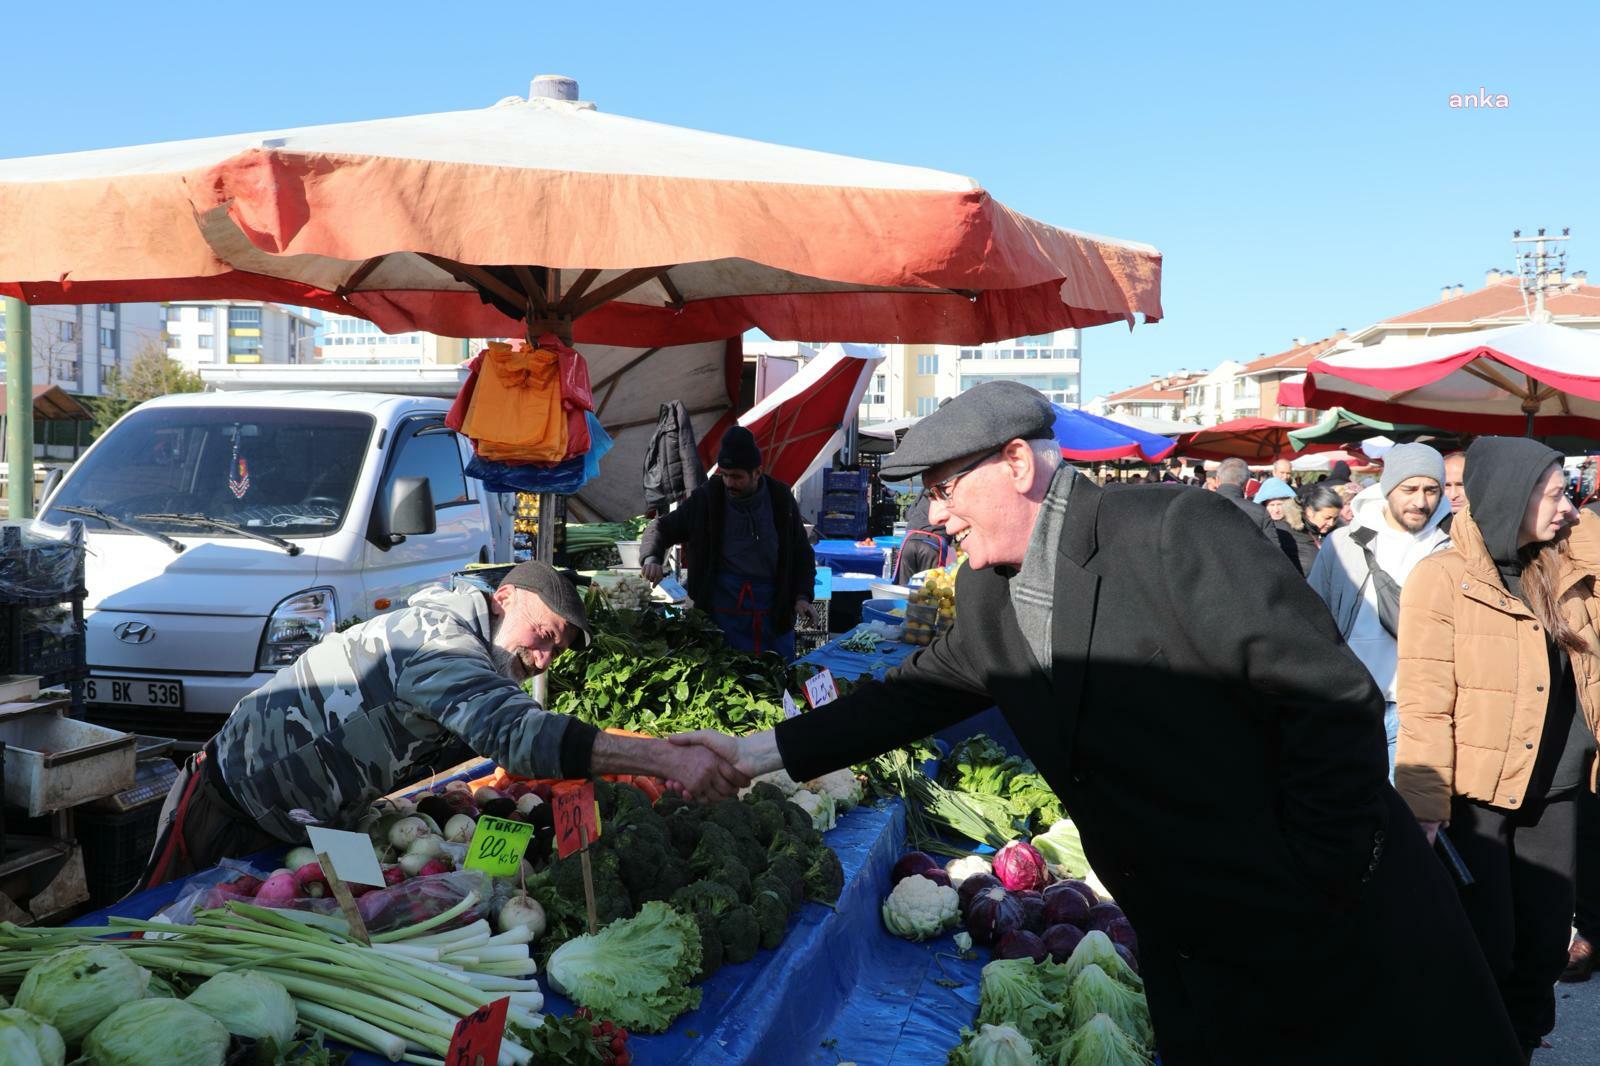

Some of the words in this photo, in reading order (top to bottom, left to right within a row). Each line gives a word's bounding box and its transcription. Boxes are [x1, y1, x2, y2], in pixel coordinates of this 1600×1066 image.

[112, 681, 132, 702] BK
[147, 683, 179, 705] 536
[479, 835, 506, 859] 20
